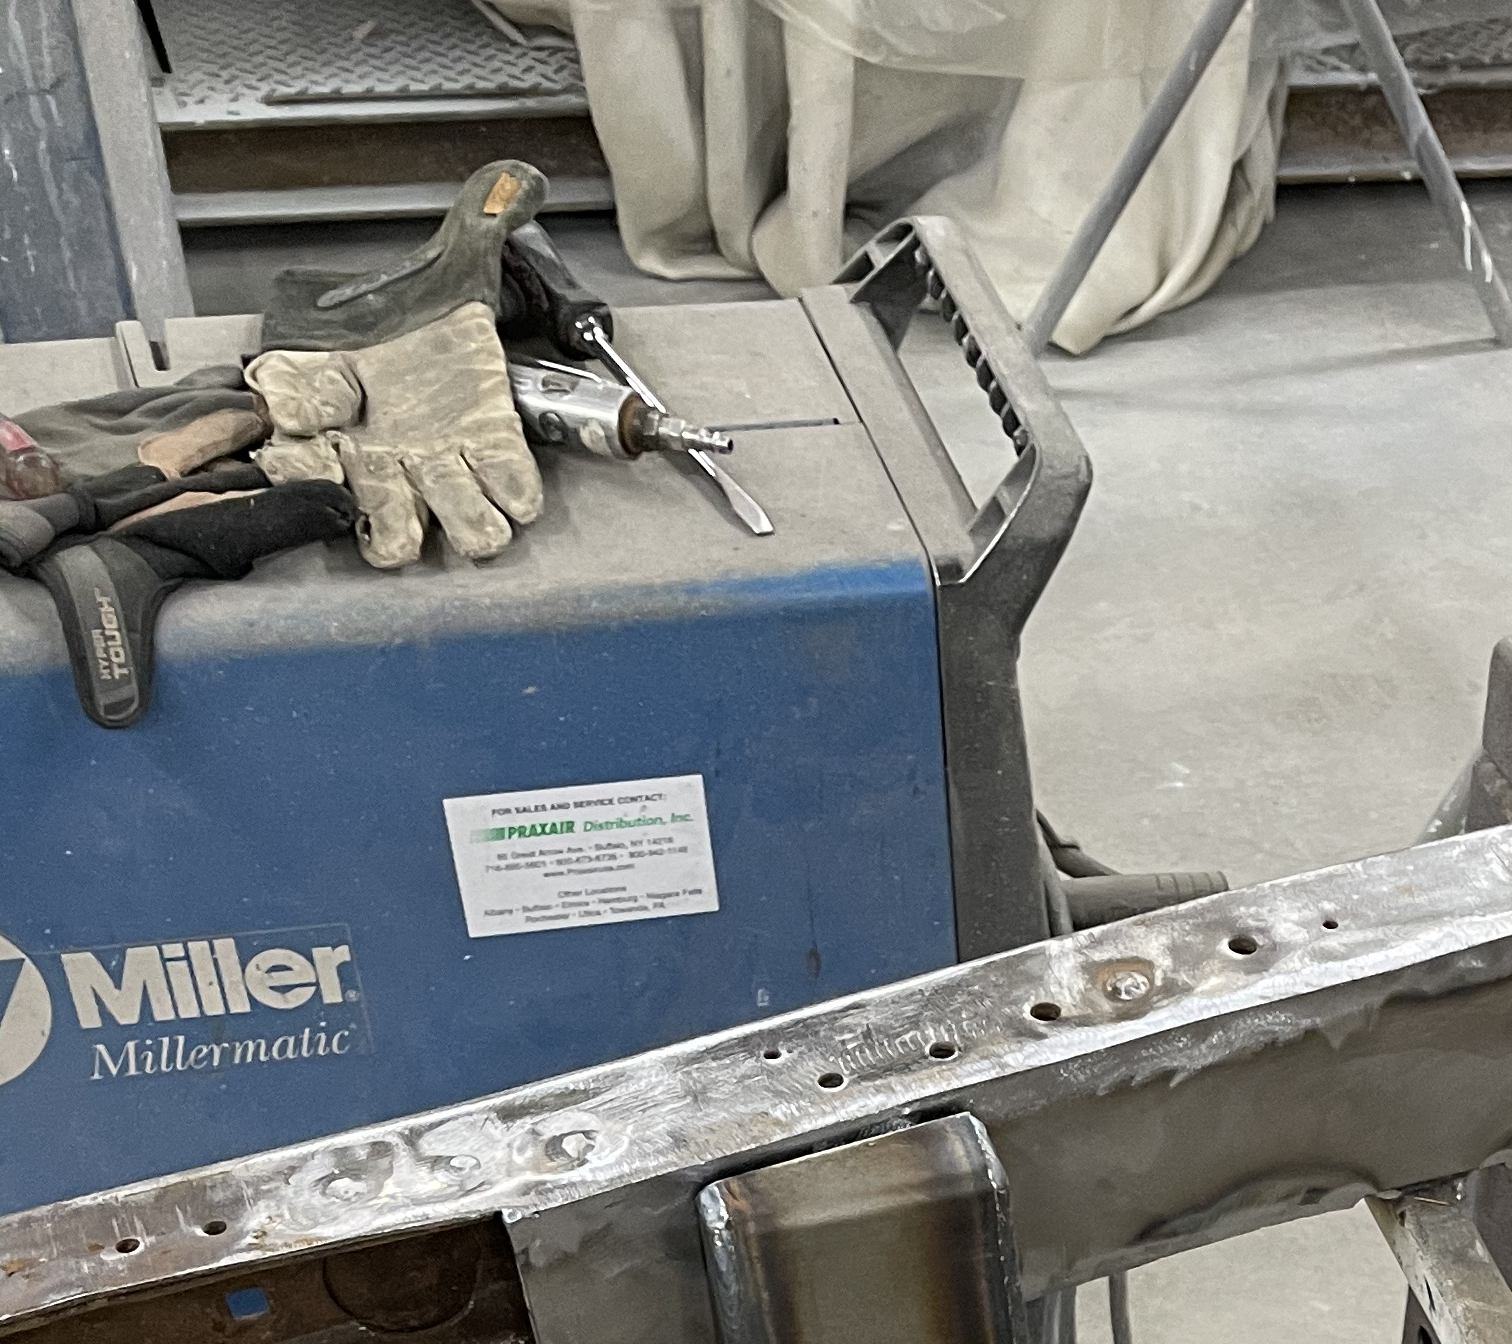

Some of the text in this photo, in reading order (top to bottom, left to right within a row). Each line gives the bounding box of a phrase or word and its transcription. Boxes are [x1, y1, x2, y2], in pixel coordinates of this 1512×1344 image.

[91, 628, 112, 680] HYPER
[97, 596, 130, 680] TOUGH
[492, 808, 512, 816] FOR
[514, 804, 547, 814] SALES
[549, 802, 571, 811] AND
[573, 798, 614, 809] SERVICE
[507, 811, 694, 840] PRAXAIR Distribution, Inc.
[60, 937, 351, 1029] Miller
[90, 1020, 351, 1081] Millermatic
